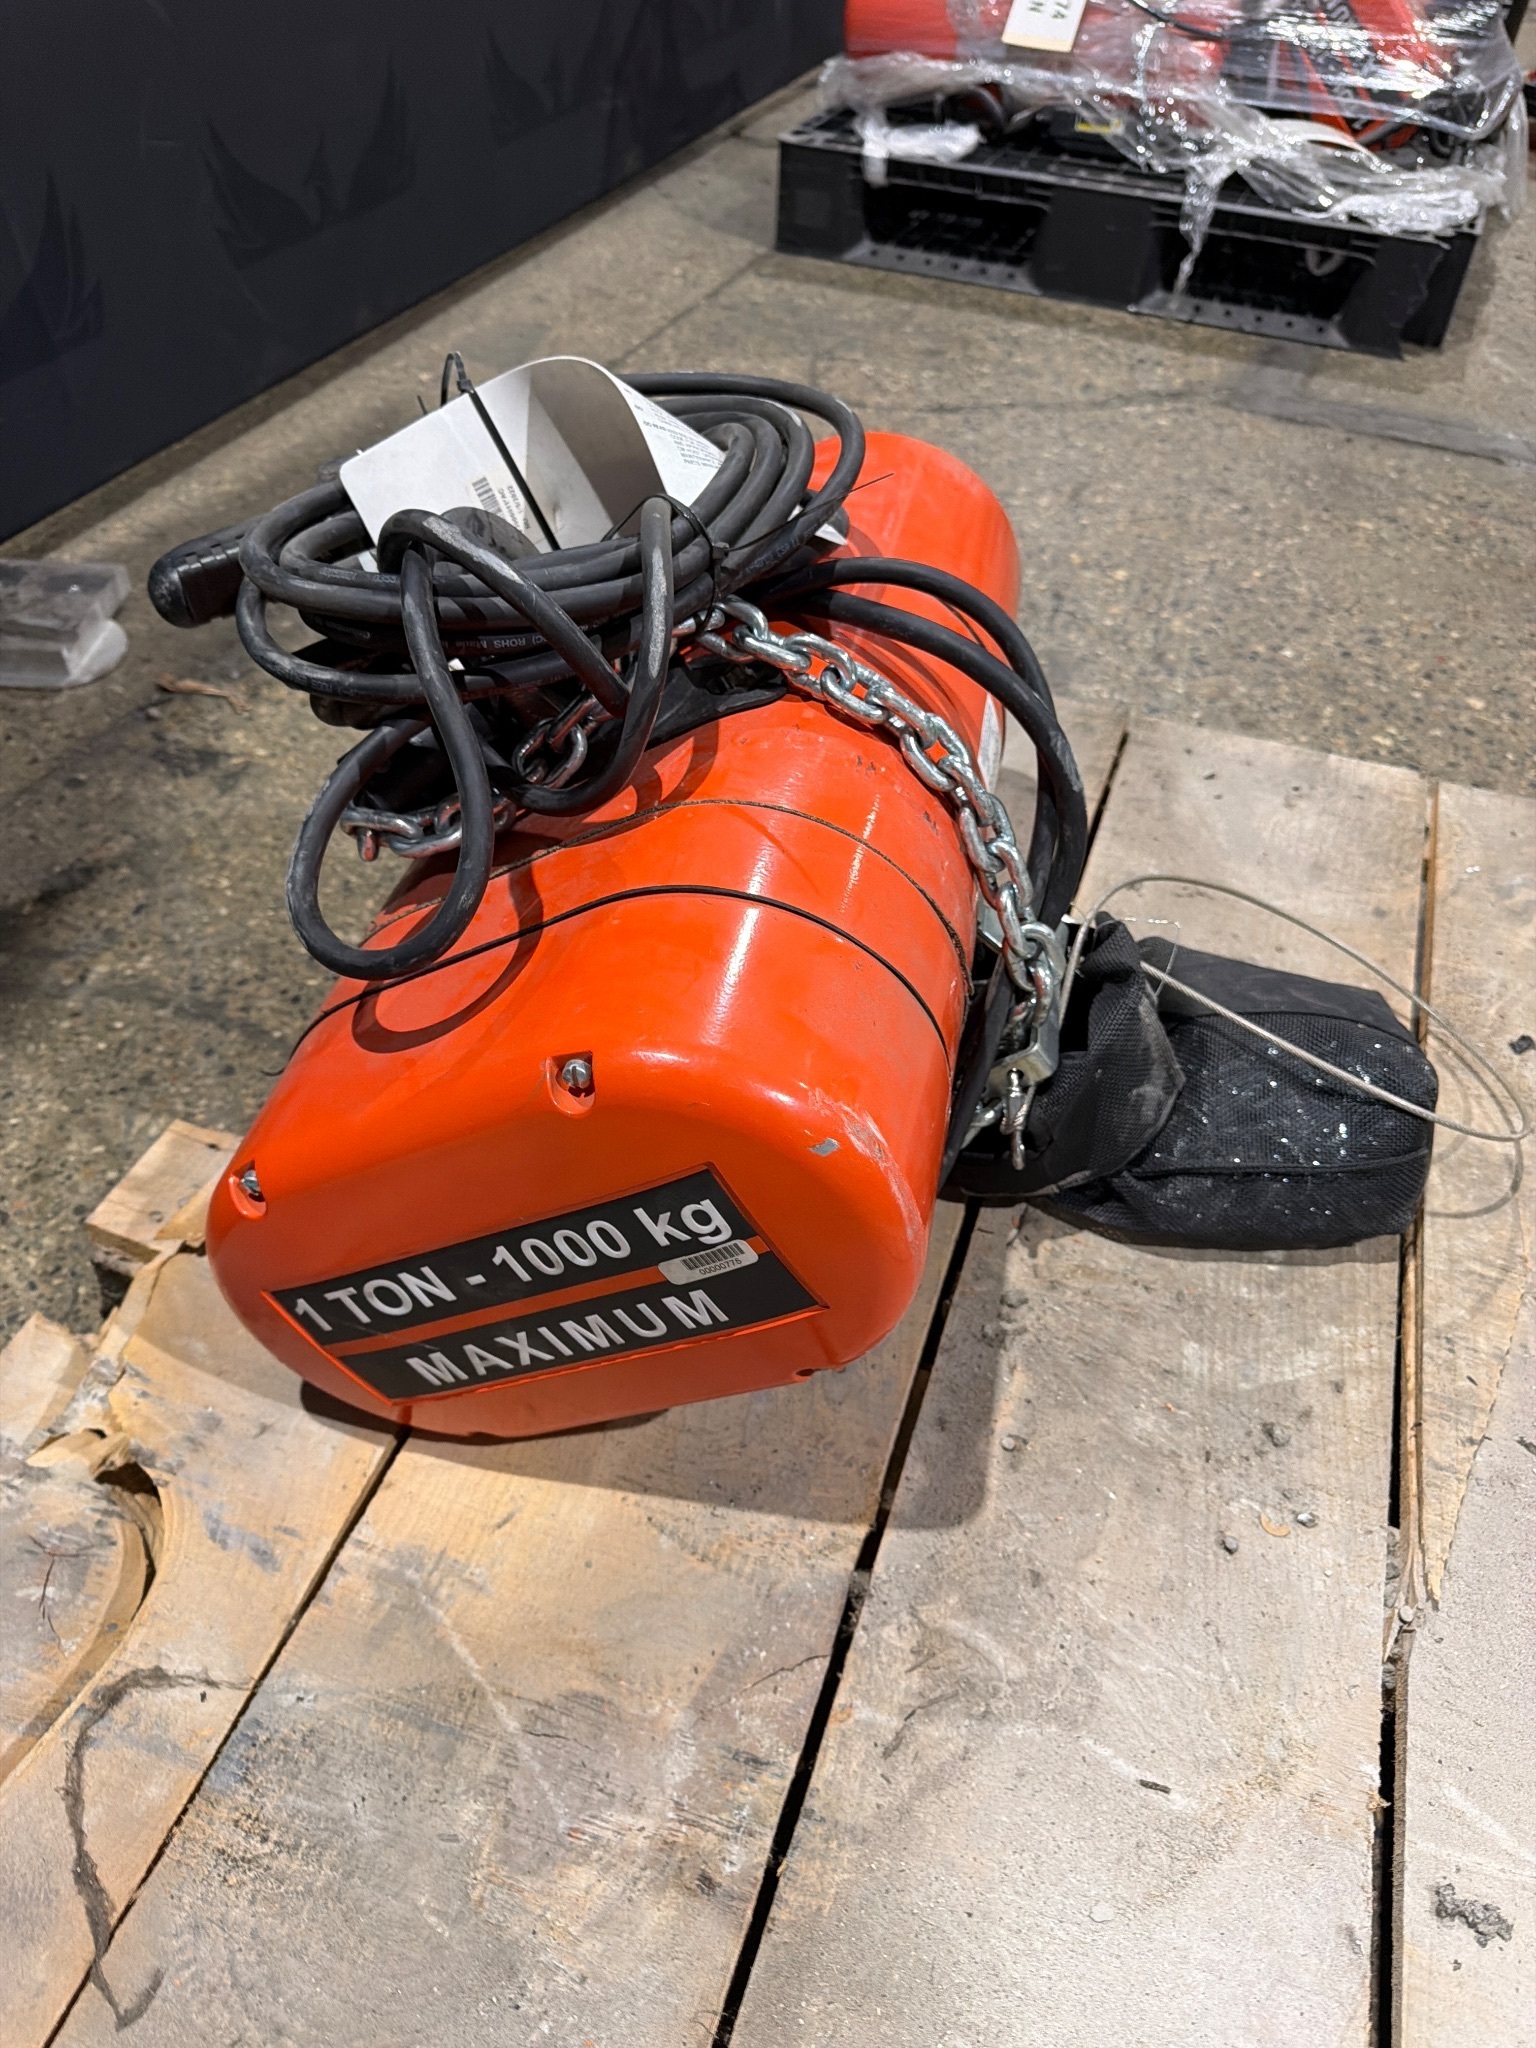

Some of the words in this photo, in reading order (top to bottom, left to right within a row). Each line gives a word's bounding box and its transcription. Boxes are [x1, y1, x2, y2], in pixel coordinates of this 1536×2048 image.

[493, 637, 526, 649] ROHS
[293, 1298, 333, 1332] 1
[324, 1265, 458, 1324] TON
[491, 1219, 632, 1283] 1000
[633, 1198, 733, 1248] kg
[405, 1288, 730, 1387] MAXIMUM
